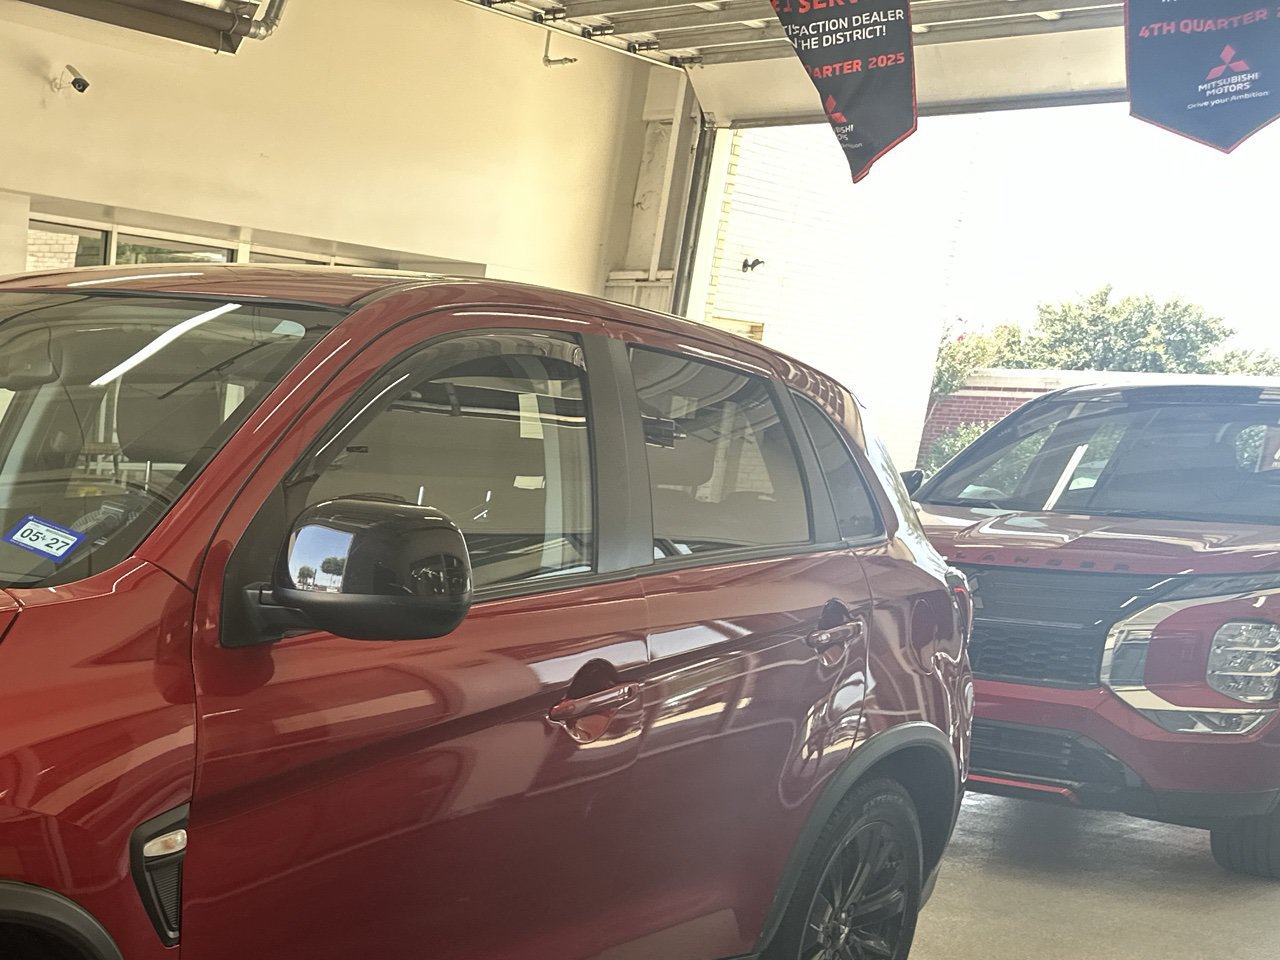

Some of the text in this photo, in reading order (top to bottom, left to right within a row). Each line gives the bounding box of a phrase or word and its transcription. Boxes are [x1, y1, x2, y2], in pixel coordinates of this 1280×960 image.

[852, 9, 904, 28] DEALER
[1138, 21, 1176, 38] 4TH
[1180, 8, 1268, 34] QUARTER
[822, 25, 886, 47] DISTRICT!
[868, 52, 905, 70] 2025
[1198, 72, 1259, 92] MITSUBISHI
[1206, 82, 1251, 97] MOTORS
[1187, 91, 1269, 110] Drive your Ambition
[20, 528, 43, 542] 05
[44, 537, 70, 551] 27
